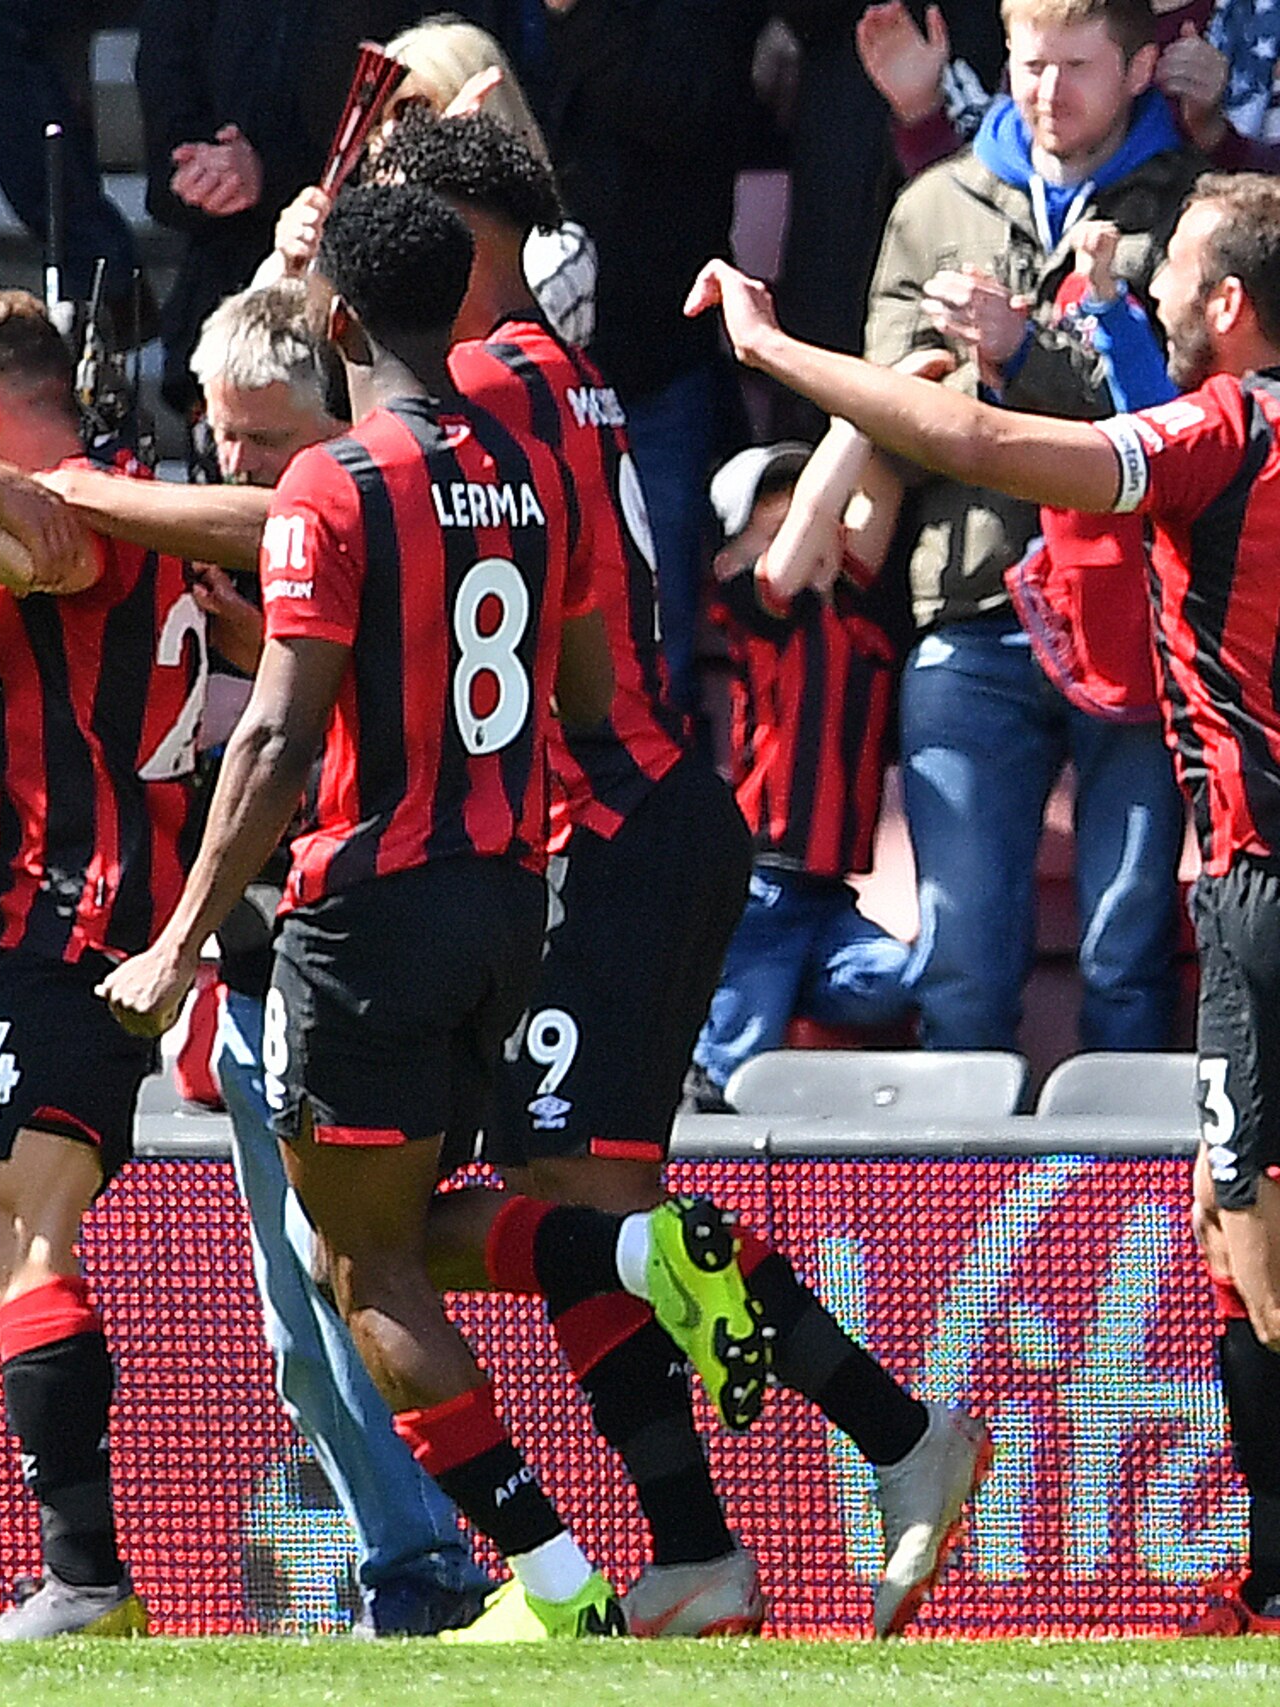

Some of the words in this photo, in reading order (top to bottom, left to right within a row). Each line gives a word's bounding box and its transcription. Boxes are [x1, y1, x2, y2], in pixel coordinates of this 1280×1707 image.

[431, 482, 545, 527] LERMA
[453, 558, 529, 754] 8
[263, 987, 288, 1076] 8
[527, 1008, 578, 1095] 9
[1200, 1058, 1235, 1145] 3
